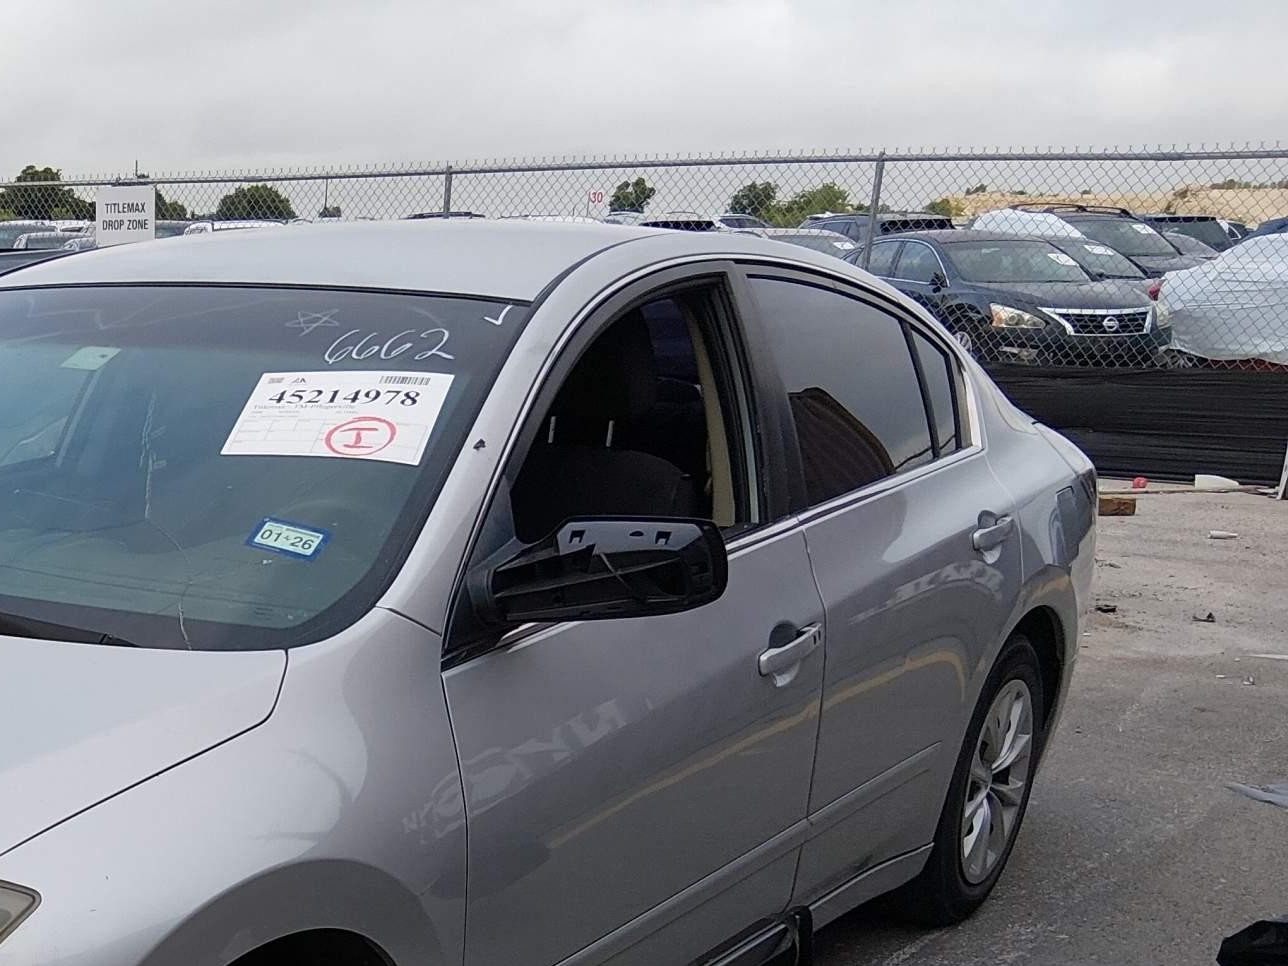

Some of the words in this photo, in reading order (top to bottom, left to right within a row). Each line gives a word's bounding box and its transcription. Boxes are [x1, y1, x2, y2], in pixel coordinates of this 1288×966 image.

[591, 191, 603, 203] 30
[105, 202, 146, 214] TITLEMAX
[102, 220, 124, 231] DROP
[127, 219, 149, 230] ZONE
[323, 327, 456, 365] 6662
[268, 389, 421, 407] 45214978
